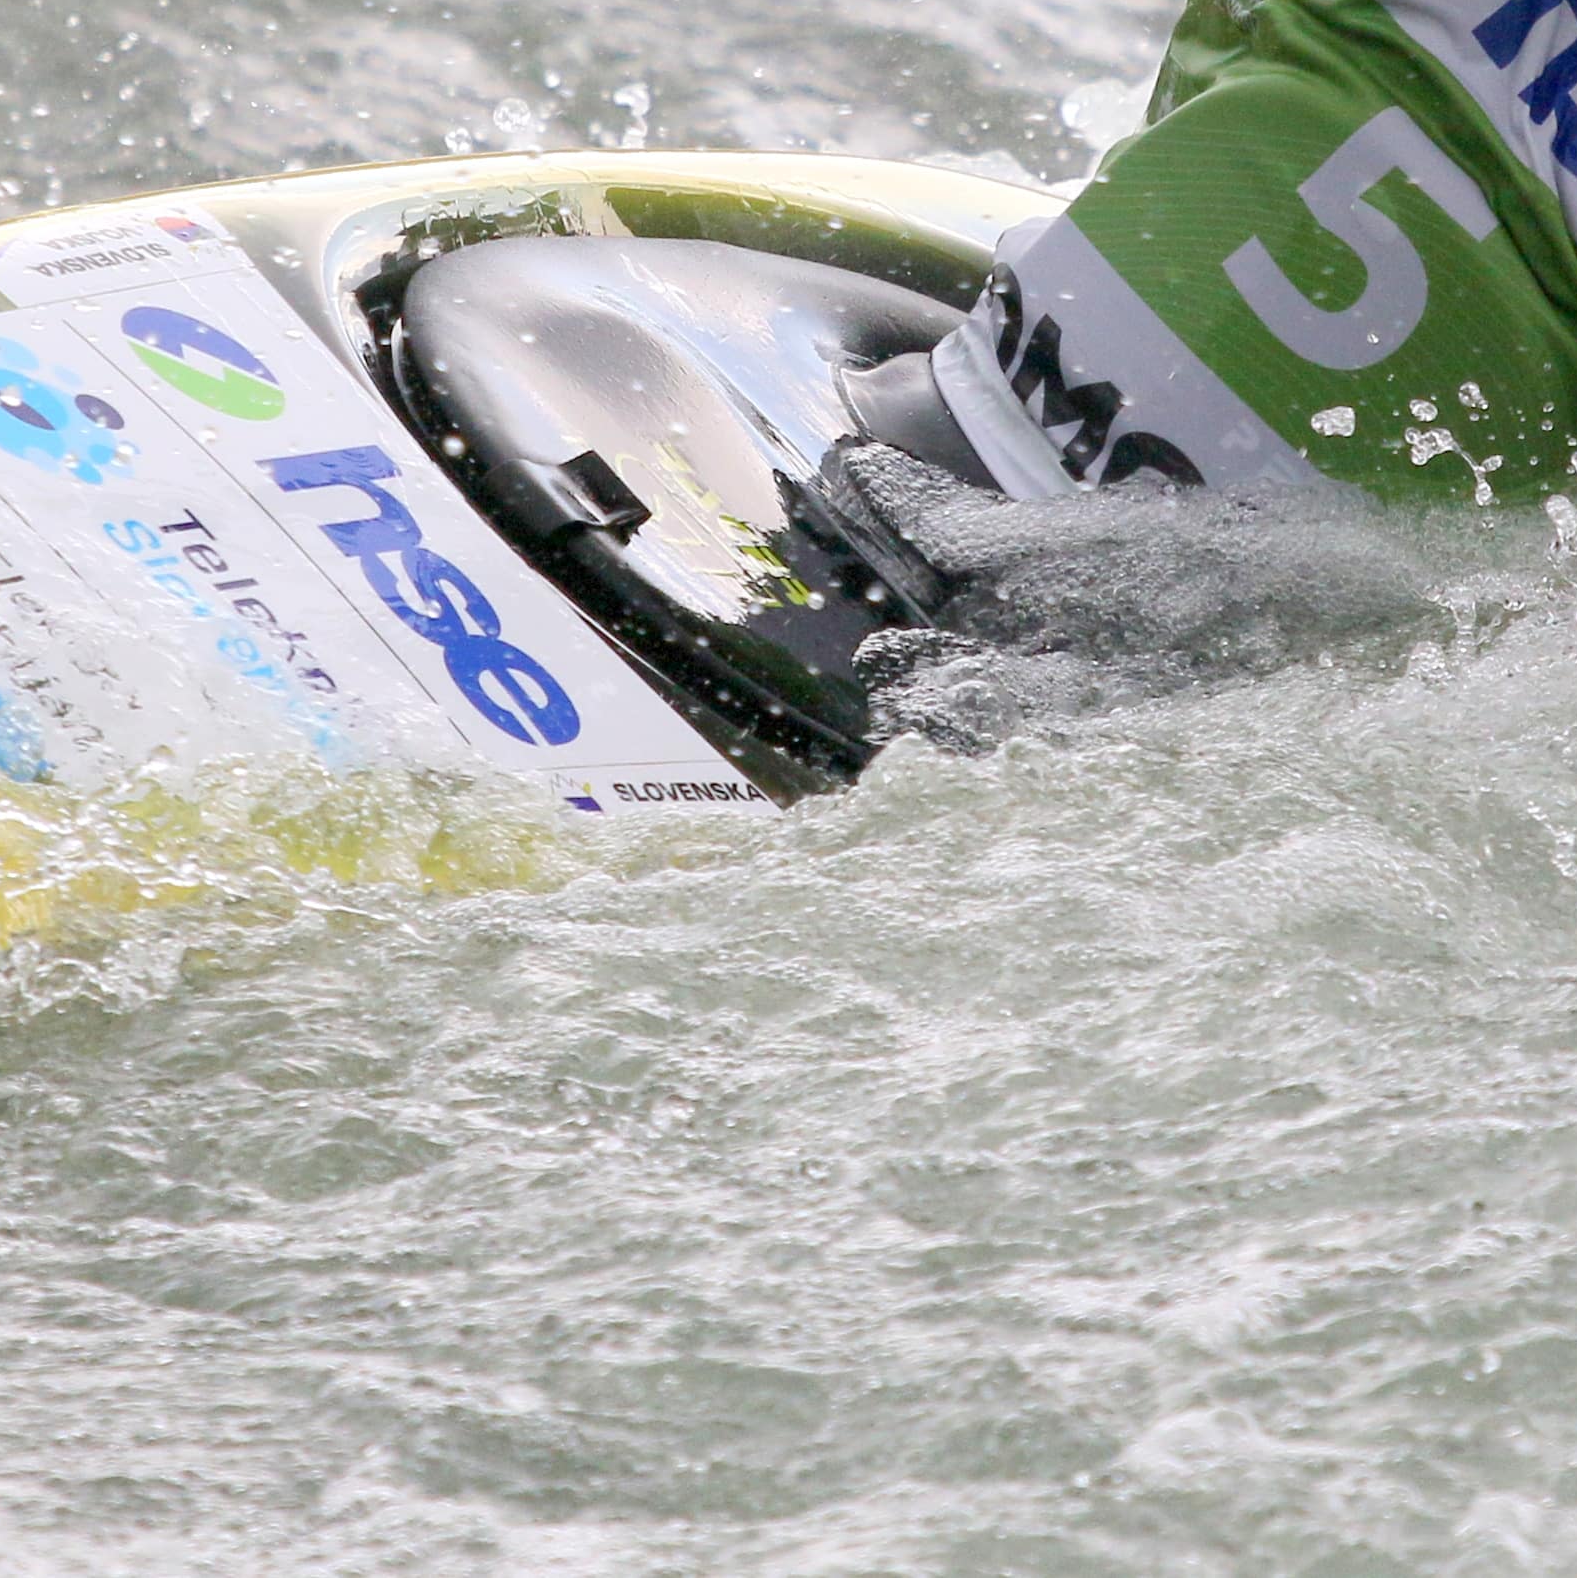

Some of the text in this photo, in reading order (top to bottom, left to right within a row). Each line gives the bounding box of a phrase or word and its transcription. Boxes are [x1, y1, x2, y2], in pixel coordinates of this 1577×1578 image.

[30, 243, 172, 278] SLOVENSKA
[1222, 105, 1497, 371] 5
[256, 444, 582, 748] hse
[612, 781, 768, 803] SLOVENSKA
